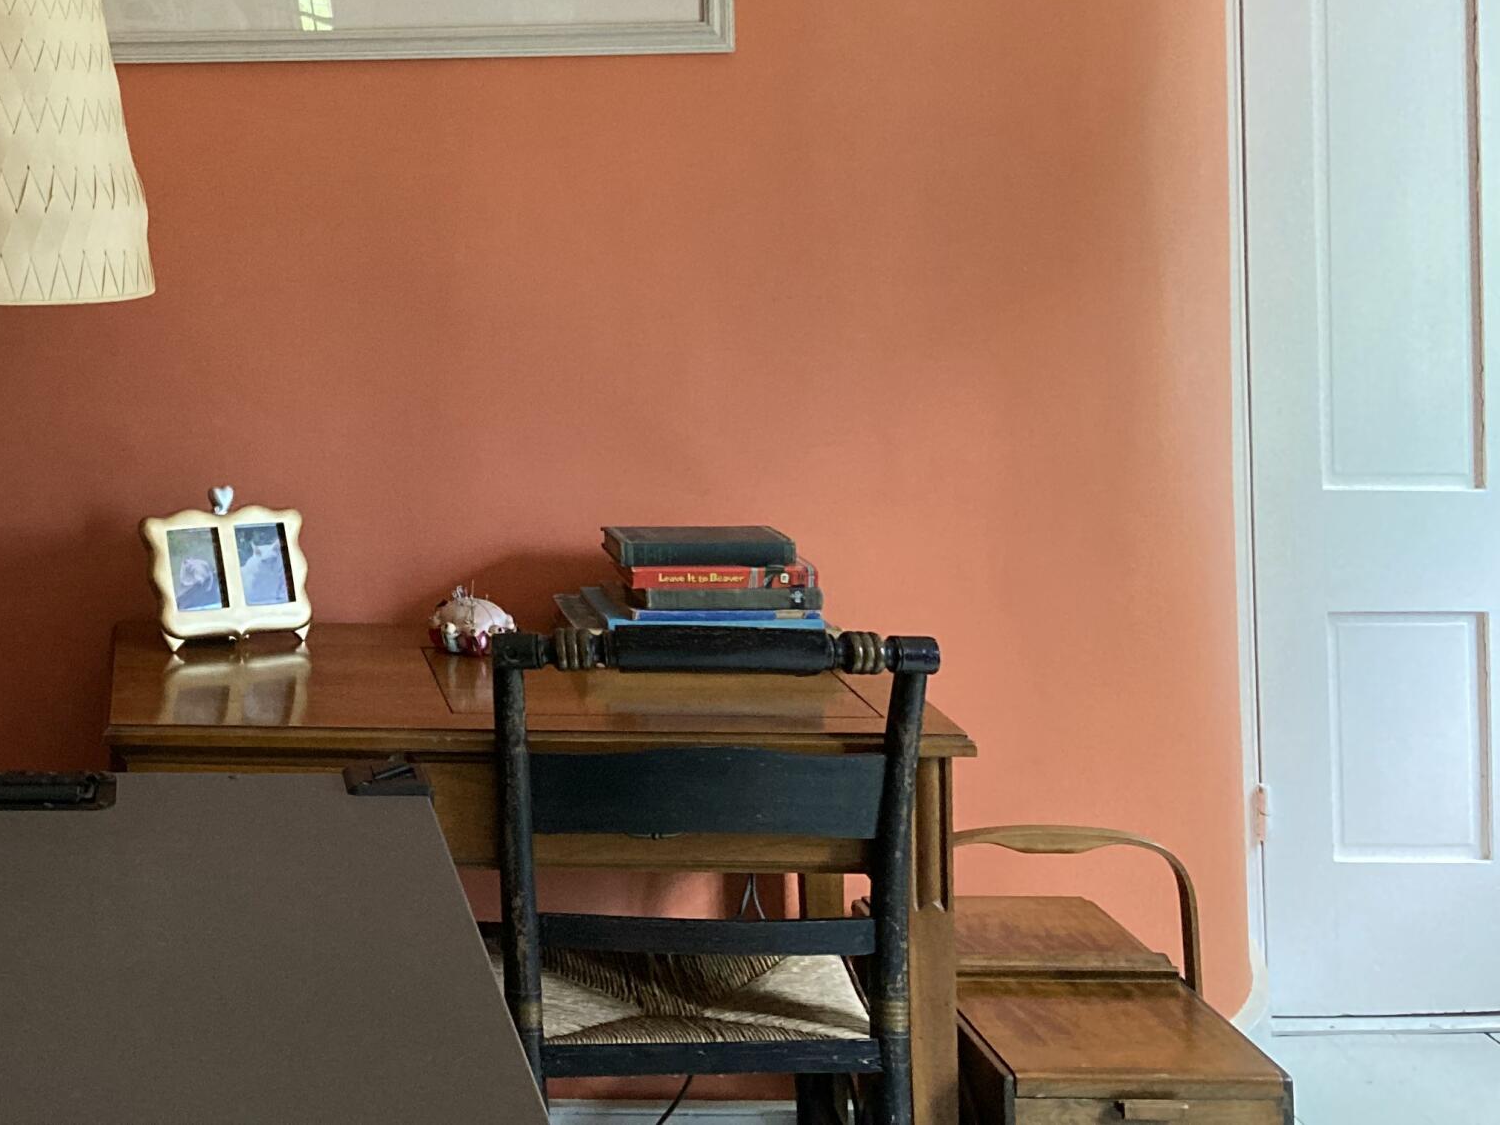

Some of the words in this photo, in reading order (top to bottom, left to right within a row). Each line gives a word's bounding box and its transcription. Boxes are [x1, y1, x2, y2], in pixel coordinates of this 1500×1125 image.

[658, 573, 685, 583] Leave
[687, 573, 696, 582] It
[698, 575, 708, 583] to
[710, 573, 744, 583] Beaver
